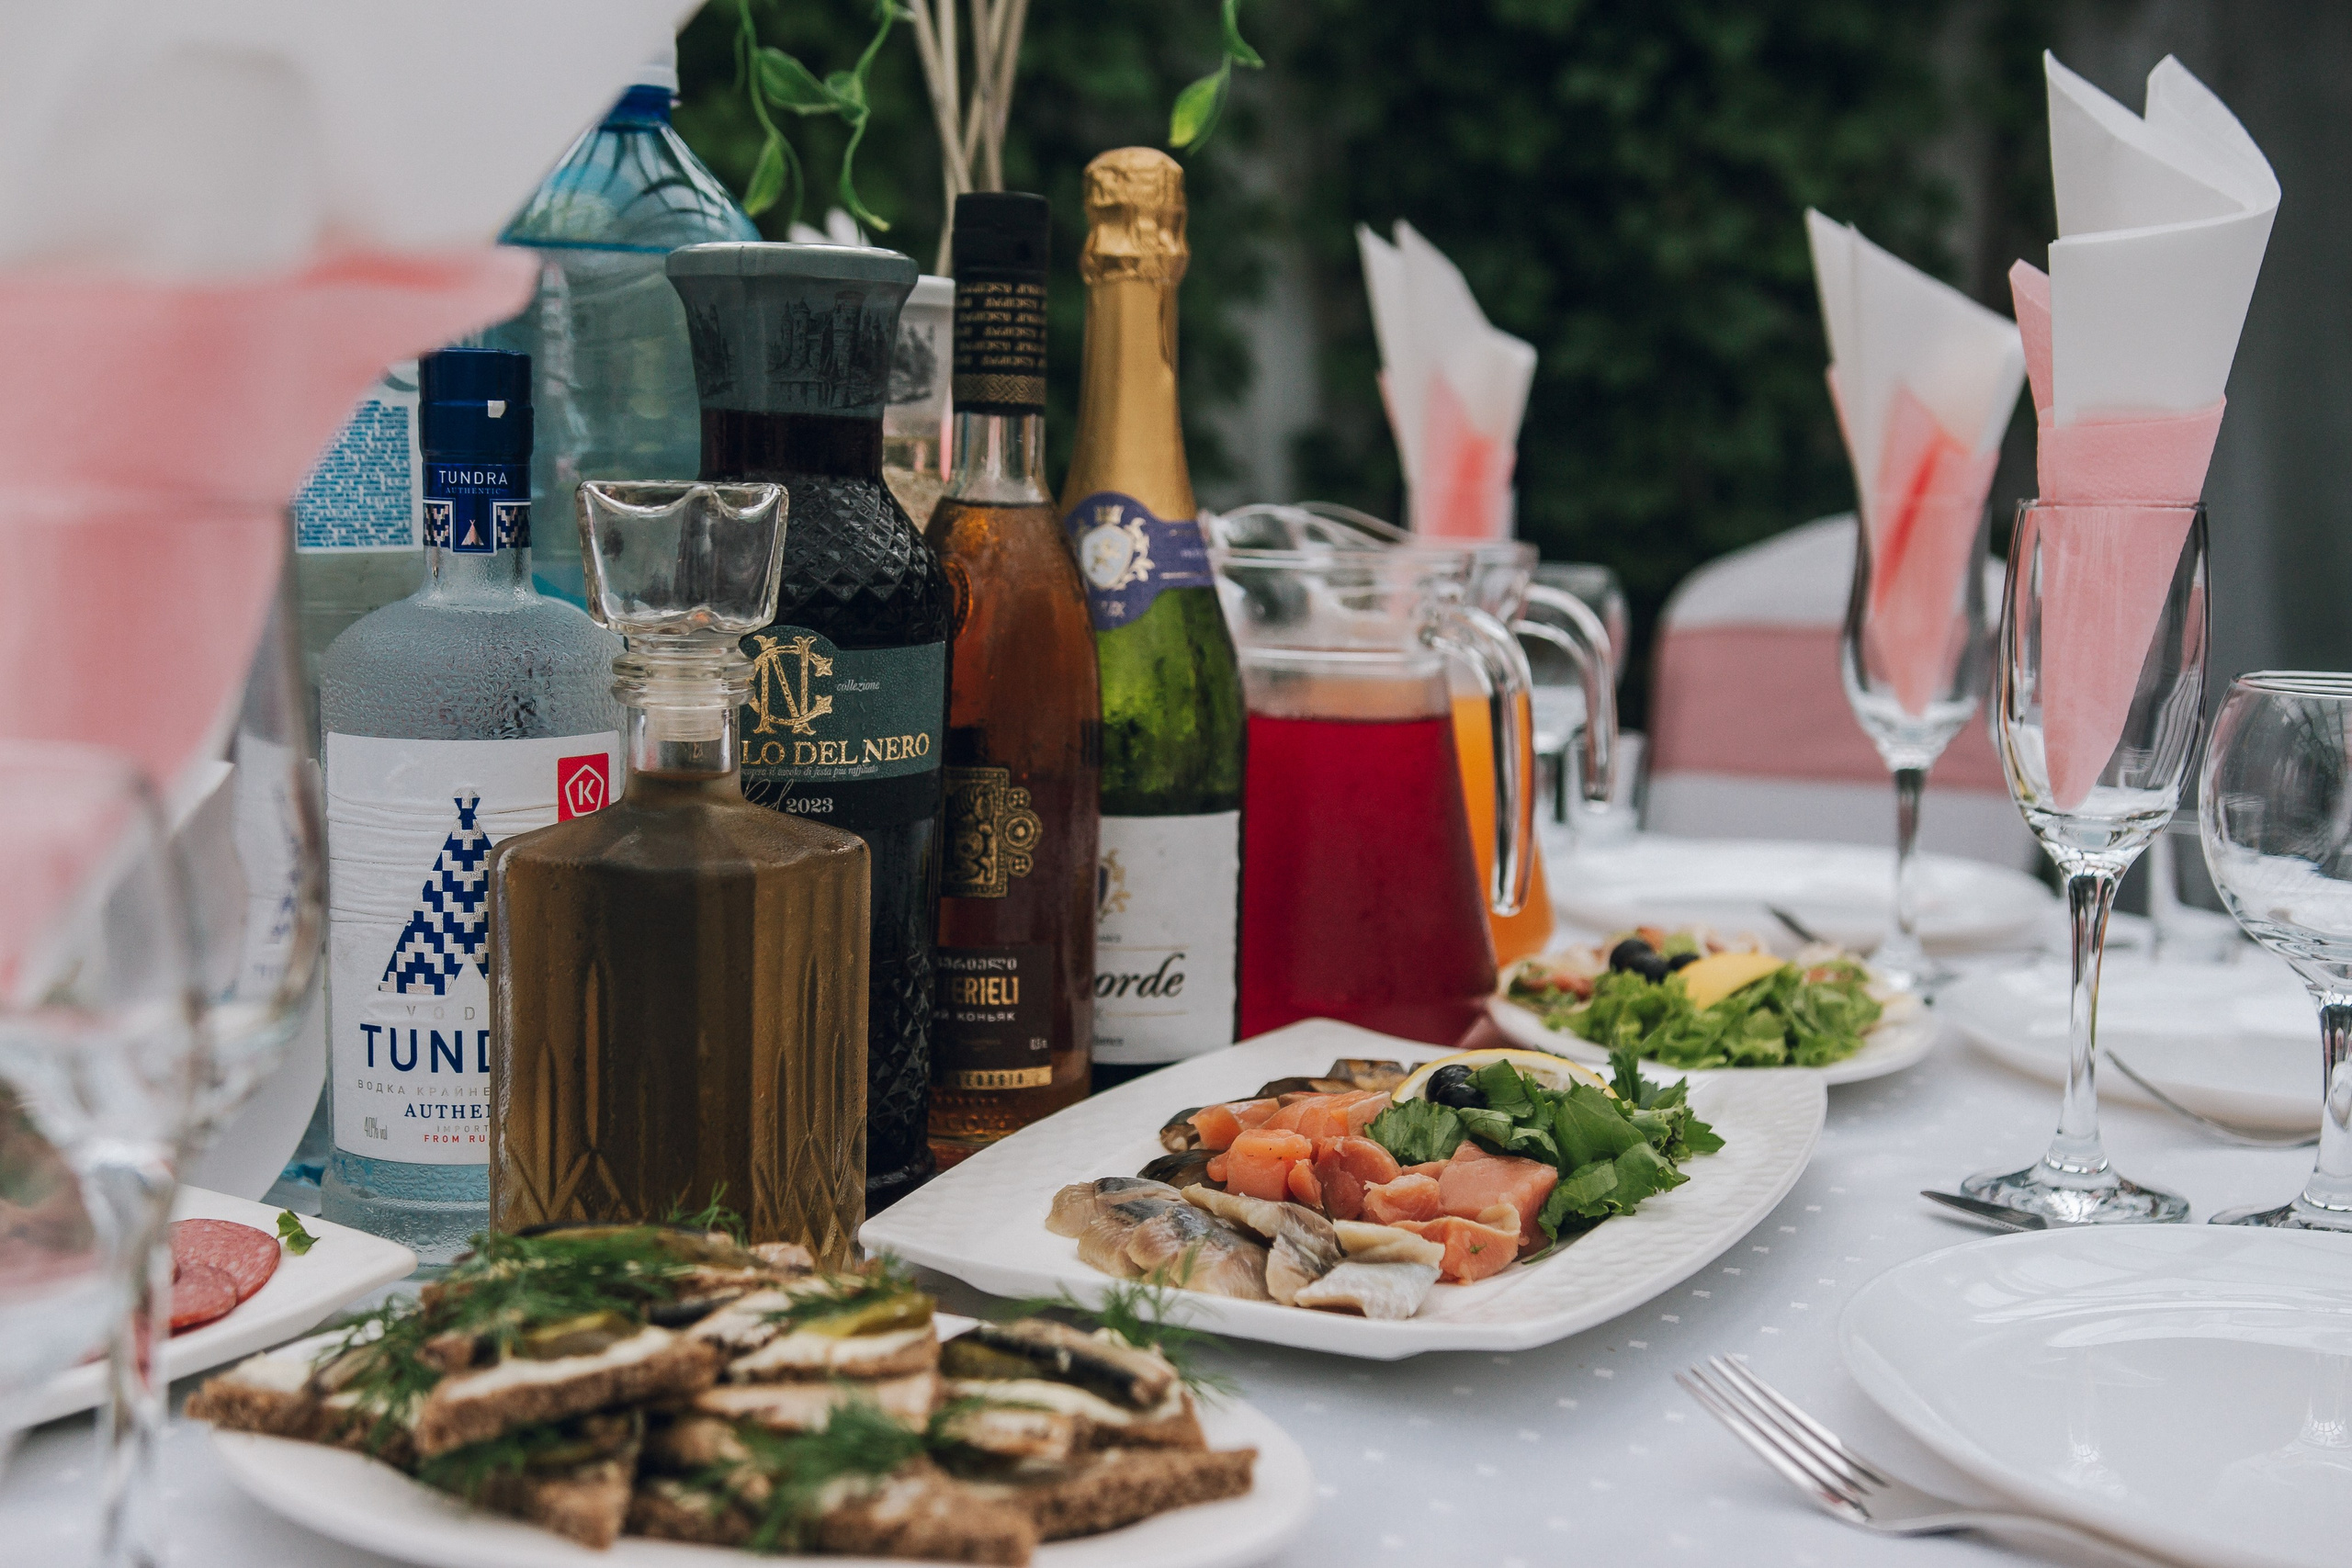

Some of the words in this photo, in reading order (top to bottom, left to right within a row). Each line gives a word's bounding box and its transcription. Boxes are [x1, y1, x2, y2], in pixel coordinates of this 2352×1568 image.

[438, 469, 508, 485] TUNDRA
[446, 487, 502, 495] AUTHENTIC
[836, 679, 880, 692] collezione
[793, 739, 858, 765] DEL
[862, 732, 931, 763] NERO
[786, 797, 834, 814] 2023
[1093, 952, 1186, 998] orde
[357, 1078, 405, 1095] ВОДКА
[364, 1116, 379, 1139] 40%
[424, 1134, 459, 1144] FROM
